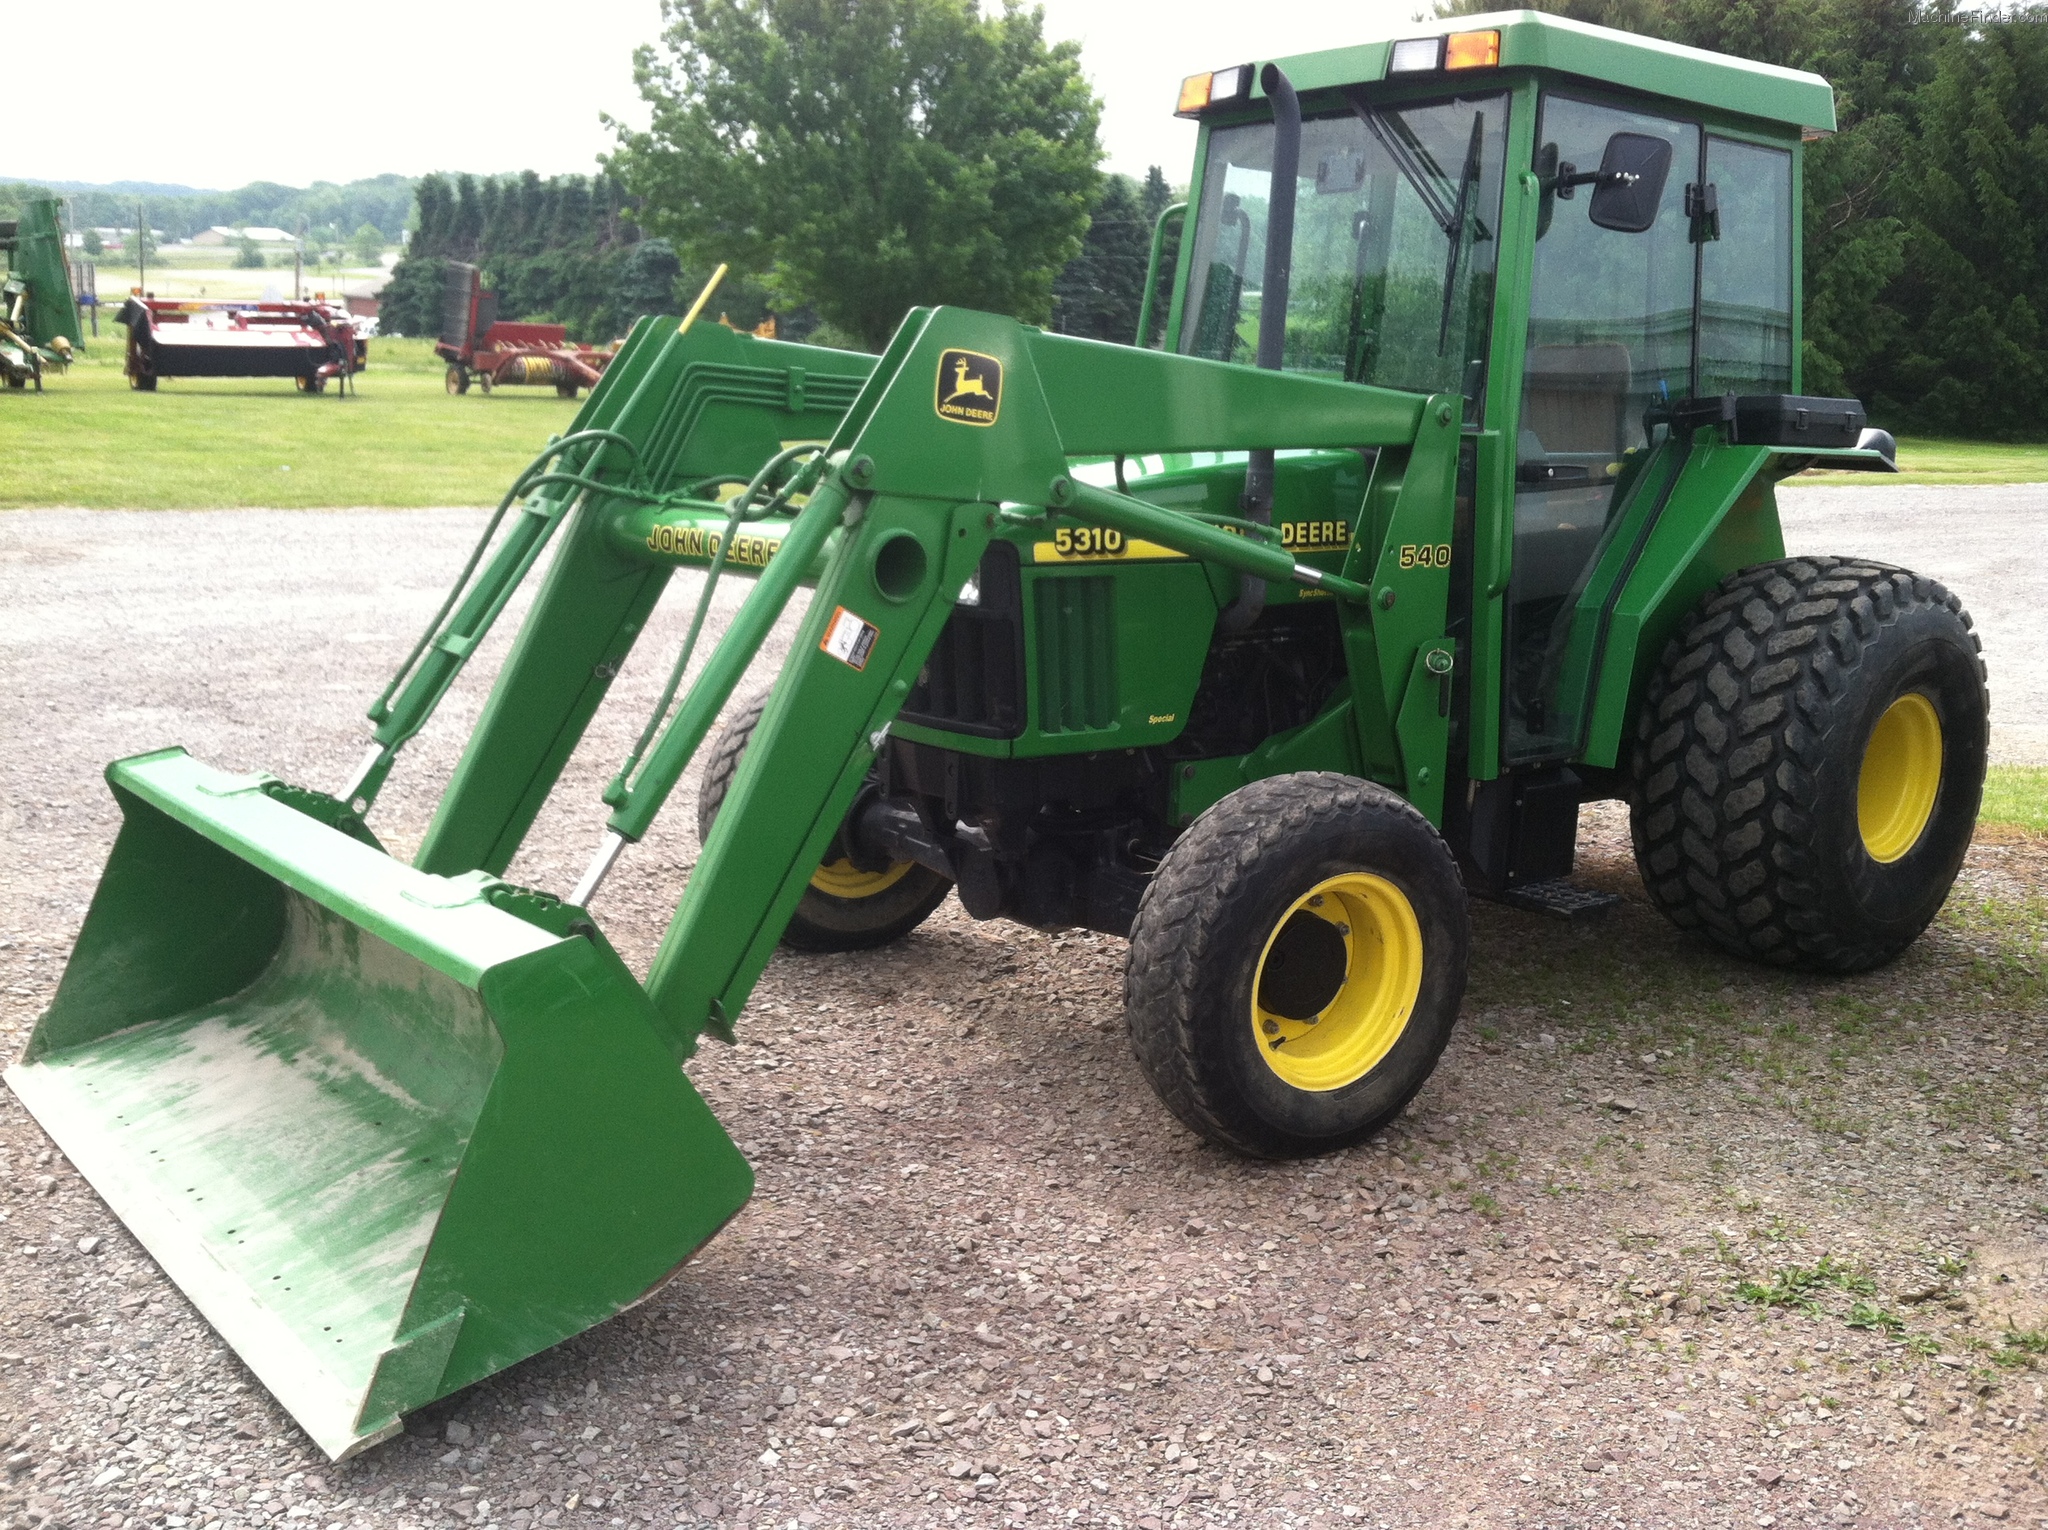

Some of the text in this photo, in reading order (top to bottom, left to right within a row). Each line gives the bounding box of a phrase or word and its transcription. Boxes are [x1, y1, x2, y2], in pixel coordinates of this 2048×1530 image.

[940, 404, 995, 421] JOHN DEERE
[647, 524, 705, 556] JOHN
[1055, 527, 1122, 552] 5310
[1281, 521, 1347, 545] DEERE
[1400, 544, 1452, 569] 540
